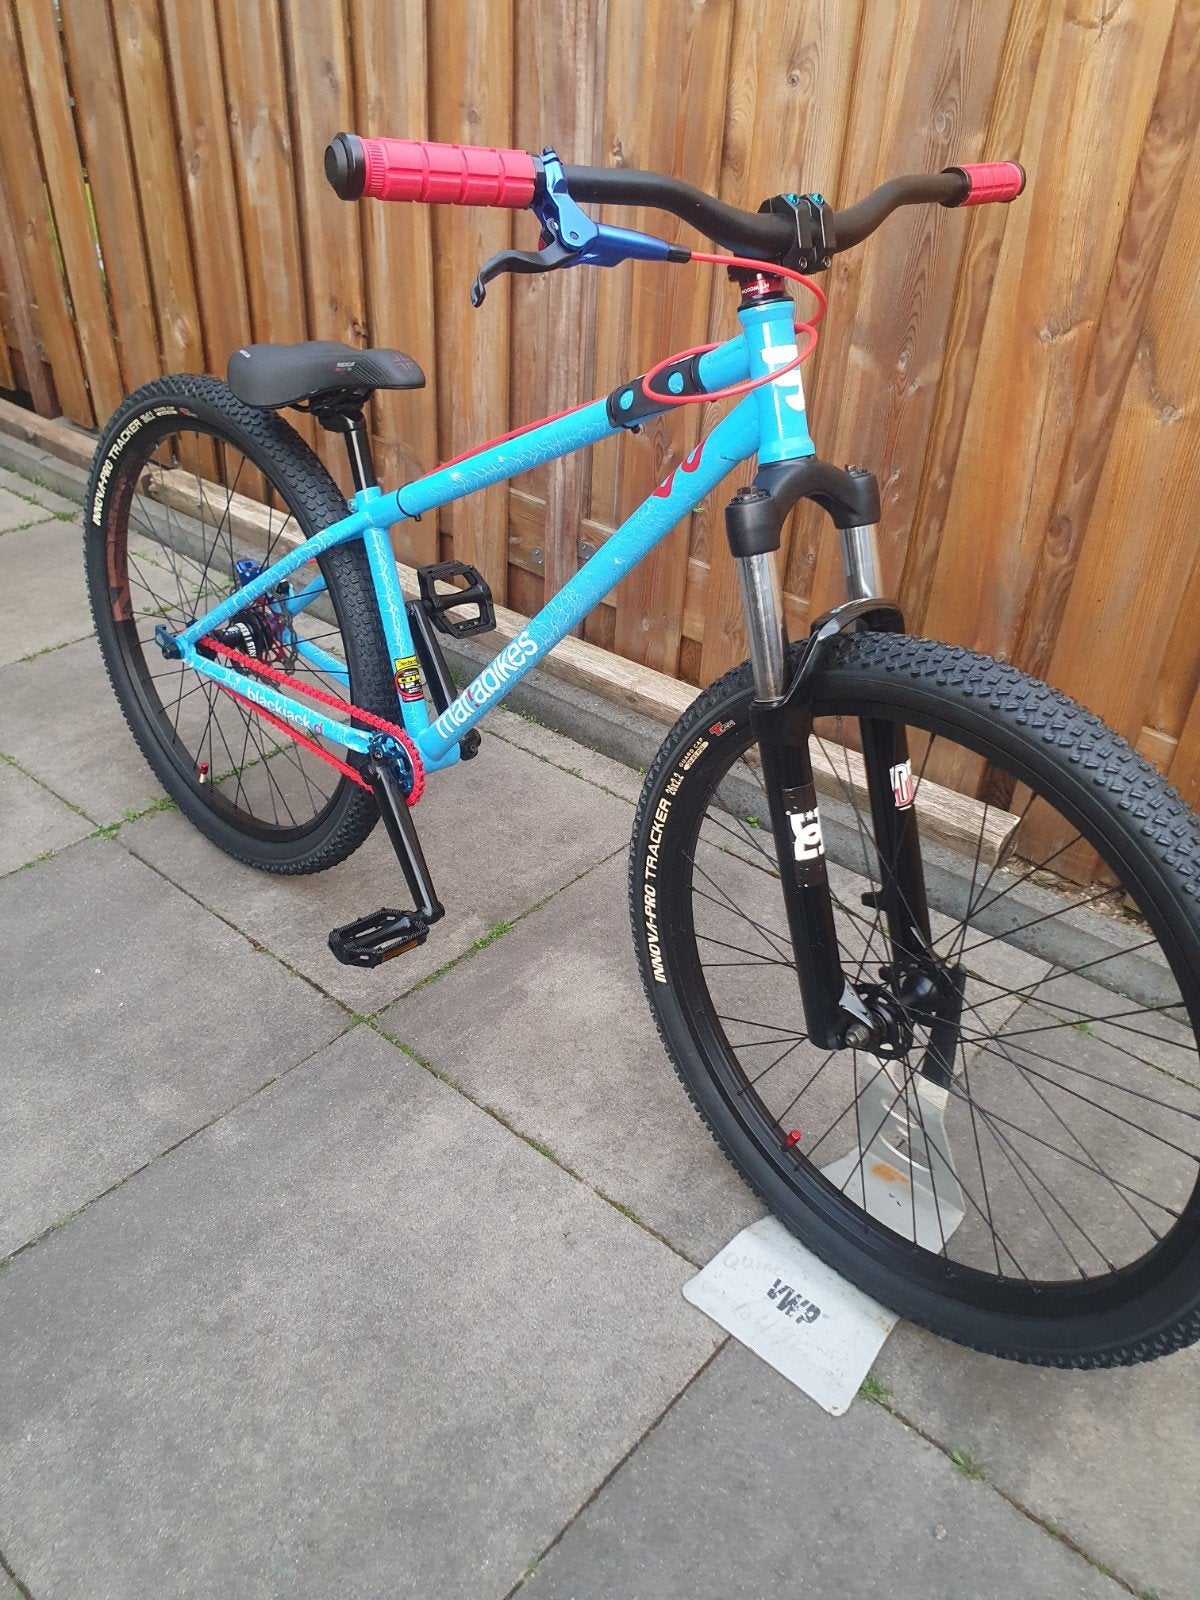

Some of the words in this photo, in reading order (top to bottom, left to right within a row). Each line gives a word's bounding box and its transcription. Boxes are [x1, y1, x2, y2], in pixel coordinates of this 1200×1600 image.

[107, 418, 142, 460] TRACKER
[678, 747, 694, 768] GUARD
[692, 737, 704, 749] CAP
[644, 797, 672, 882] TRACKER
[643, 884, 668, 984] INNOVA-PRO
